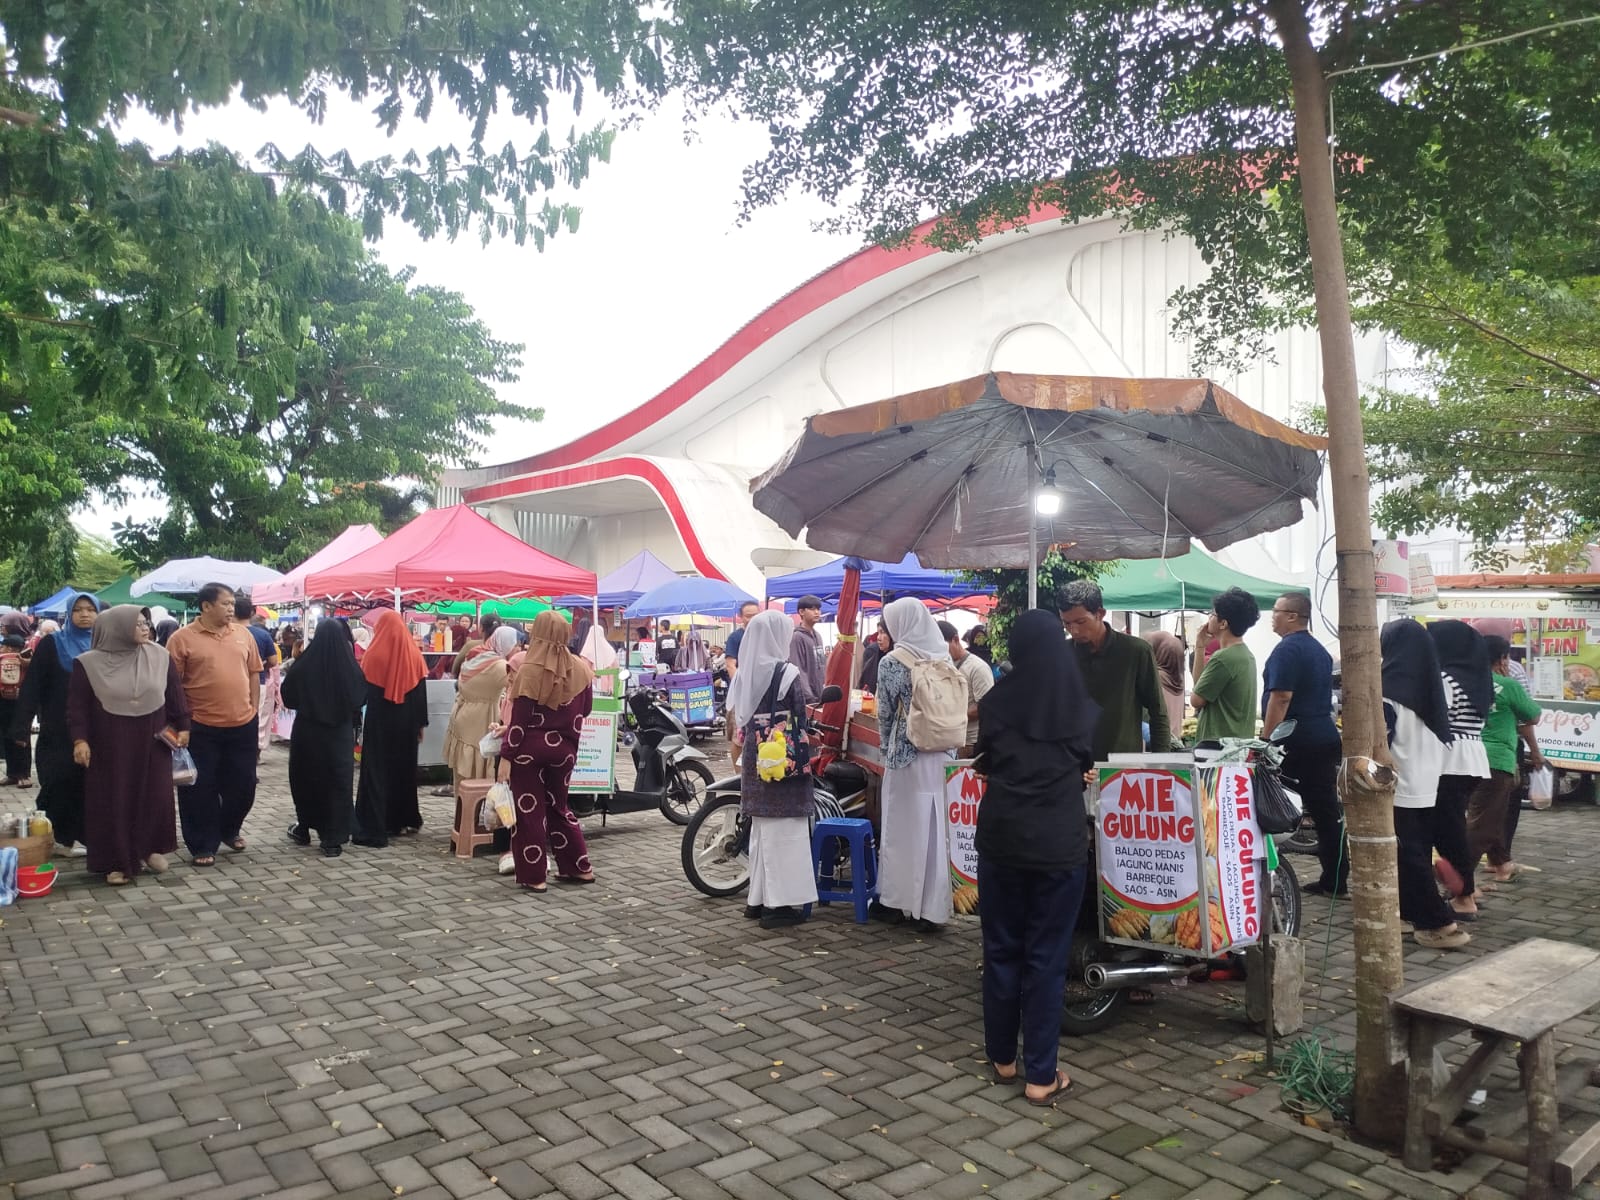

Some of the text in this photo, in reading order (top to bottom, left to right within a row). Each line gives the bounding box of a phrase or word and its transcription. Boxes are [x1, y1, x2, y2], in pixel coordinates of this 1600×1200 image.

[1538, 712, 1591, 733] epes
[1537, 738, 1562, 746] CHOCO
[1119, 775, 1175, 812] MIE
[1104, 812, 1195, 843] GULUNG
[957, 832, 975, 840] BALA
[1115, 846, 1185, 860] BALADO PEDAS
[1234, 774, 1258, 937] MIE GULUNG
[963, 865, 977, 873] SAO
[1117, 859, 1184, 873] JAGUNG MANIS
[1126, 872, 1175, 885] BARBEQUE
[1125, 885, 1147, 895] SAOS
[1157, 888, 1178, 898] ASIN
